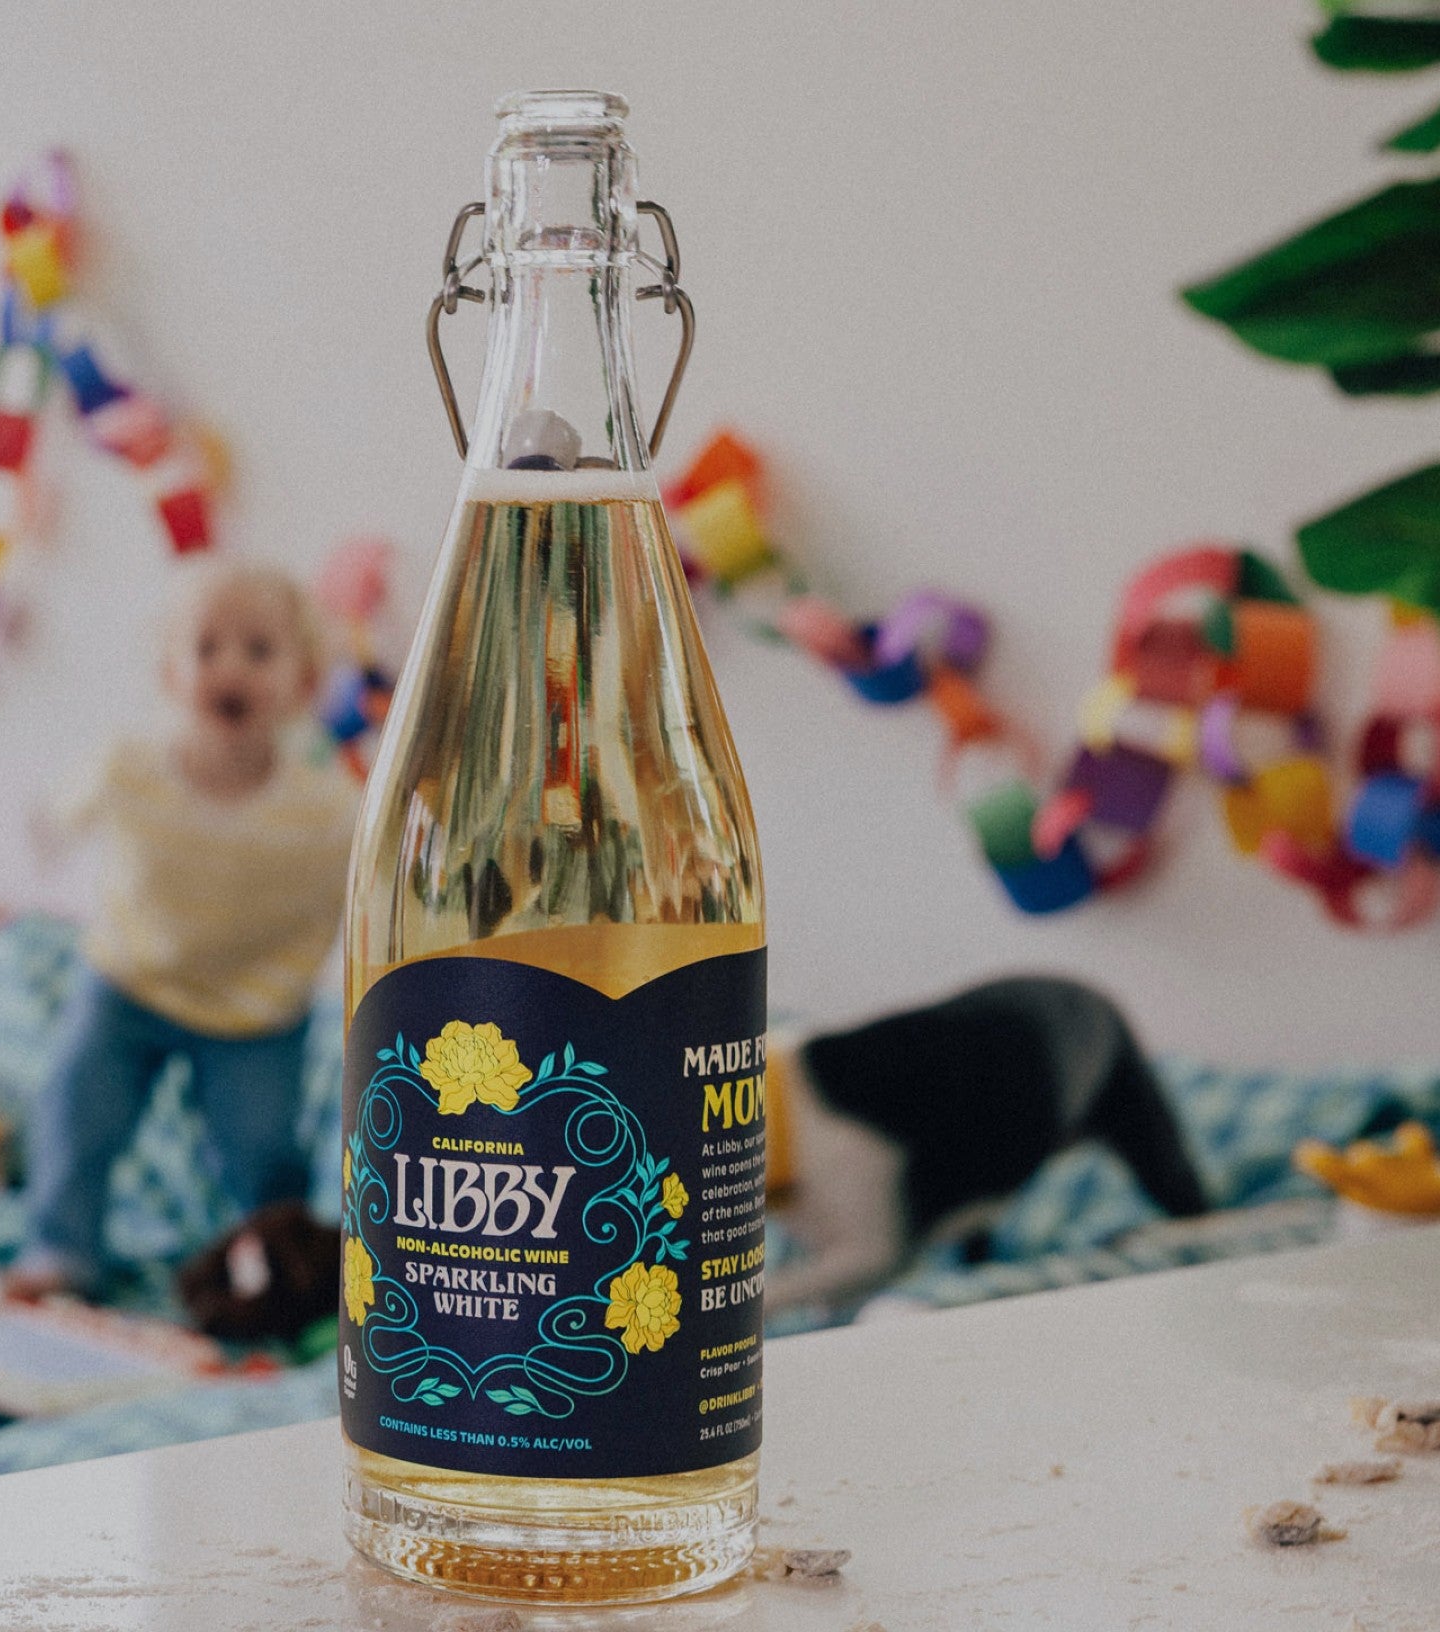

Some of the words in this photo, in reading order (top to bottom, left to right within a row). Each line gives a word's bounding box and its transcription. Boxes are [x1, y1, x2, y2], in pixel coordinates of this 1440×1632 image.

[683, 1038, 752, 1077] MADE
[702, 1073, 766, 1132] MOM
[432, 1136, 524, 1156] CALIFORNIA
[701, 1143, 715, 1157] At
[701, 1163, 727, 1179] wine
[728, 1158, 752, 1176] opens
[393, 1152, 577, 1239] LIBBY
[701, 1206, 714, 1222] of
[715, 1205, 732, 1220] the
[701, 1229, 725, 1245] that
[726, 1222, 748, 1242] good
[396, 1236, 521, 1263] NON-ALCOHOLIC
[524, 1250, 570, 1264] WINE
[405, 1261, 557, 1296] SPARKLING
[701, 1254, 739, 1281] STAY
[433, 1291, 520, 1321] WHITE
[701, 1285, 727, 1312] BE
[700, 1343, 734, 1361] FLAVOR
[700, 1365, 723, 1379] Crisp
[724, 1361, 741, 1374] Pear
[379, 1416, 428, 1437] CONTAINS
[430, 1426, 458, 1442] LESS
[460, 1431, 495, 1446] THAN
[497, 1436, 530, 1449] 0.5%
[533, 1437, 593, 1451] ALC/VOL
[700, 1426, 716, 1441] 25.4
